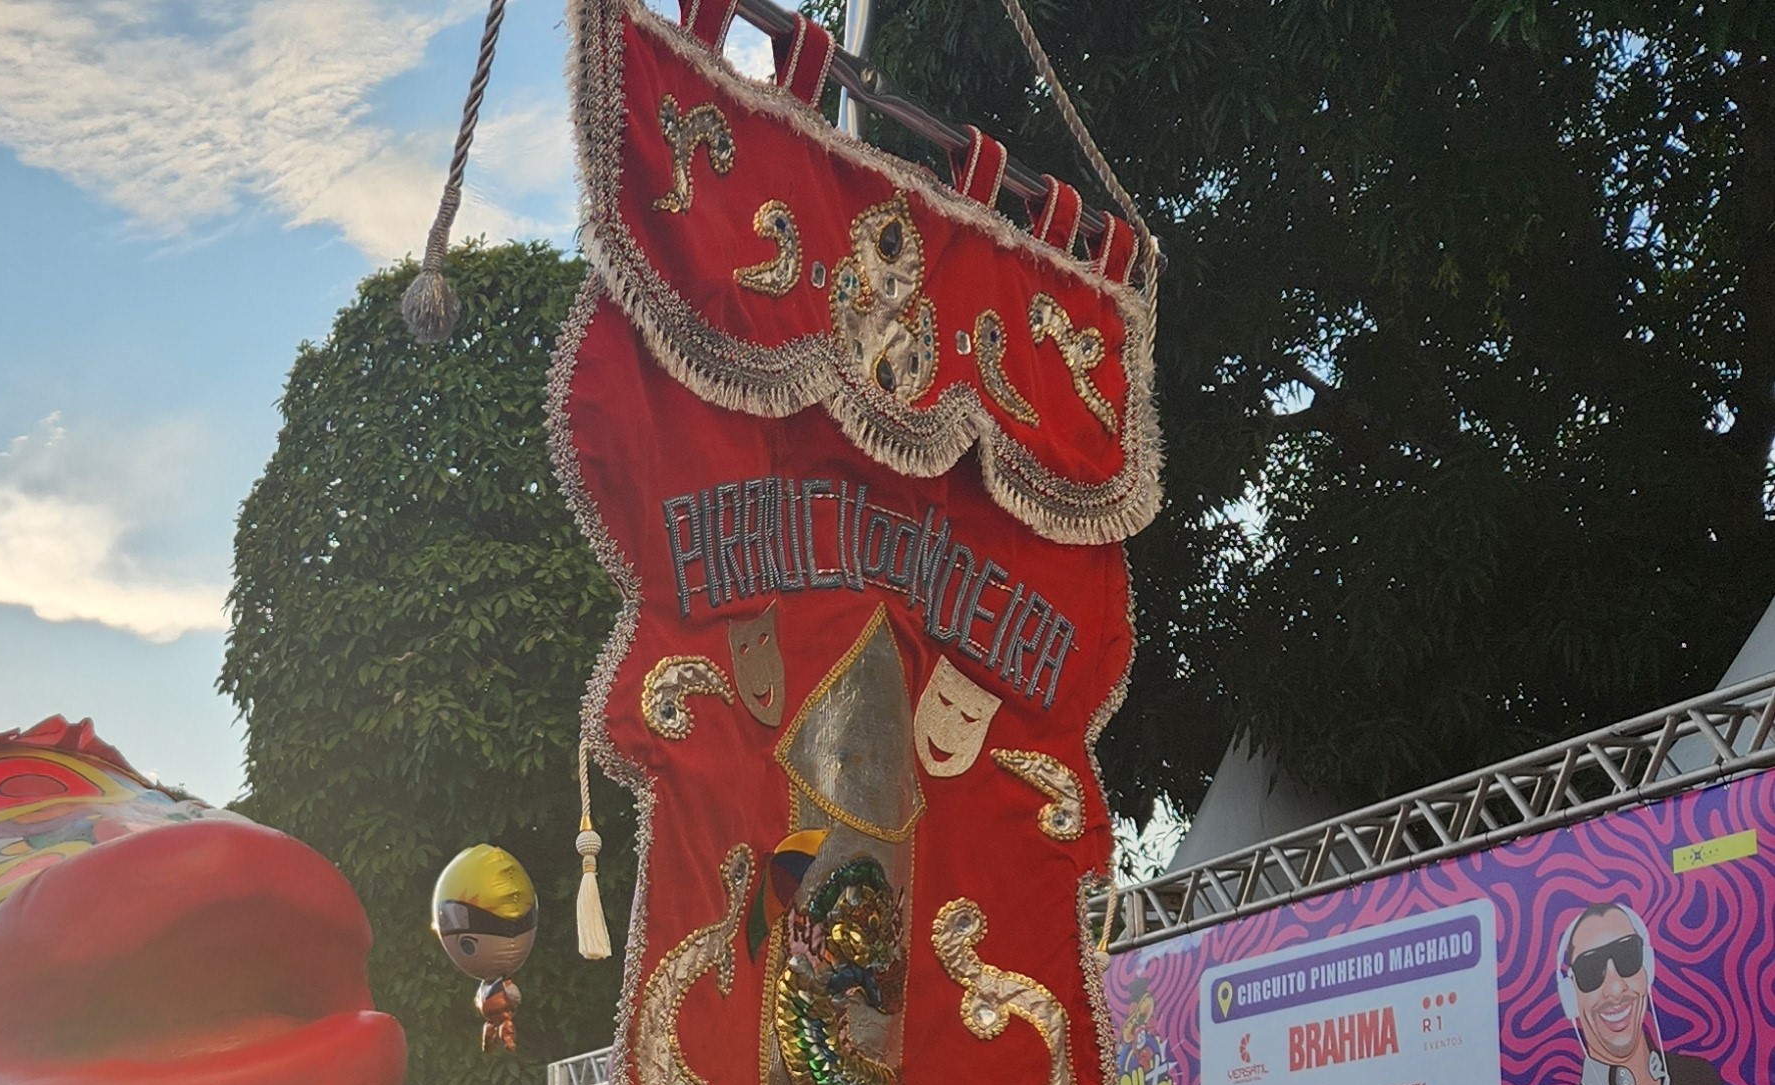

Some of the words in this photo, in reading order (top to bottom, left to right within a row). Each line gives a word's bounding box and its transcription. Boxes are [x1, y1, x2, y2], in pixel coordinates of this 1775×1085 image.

[1237, 970, 1306, 1006] CIRCUITO
[1310, 951, 1384, 990] PINHEIRO
[1389, 930, 1473, 973] MACHADO
[1289, 1006, 1399, 1072] BRAHMA
[1424, 1036, 1463, 1051] EVENTOS
